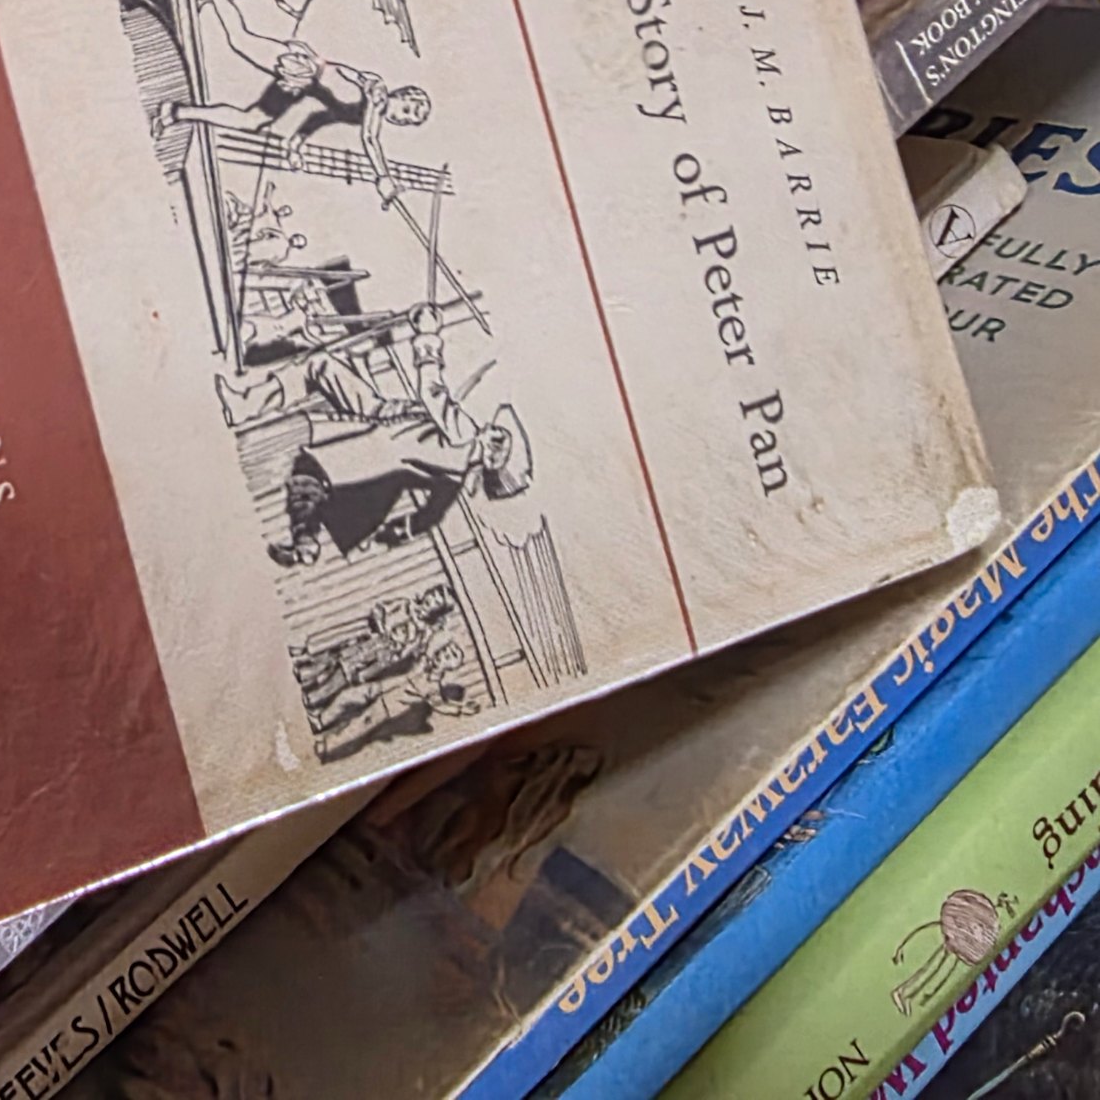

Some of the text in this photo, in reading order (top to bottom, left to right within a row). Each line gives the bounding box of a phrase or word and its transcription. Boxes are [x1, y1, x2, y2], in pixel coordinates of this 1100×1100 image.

[672, 152, 729, 207] of
[738, 5, 841, 287] J. M. BARRIE
[692, 224, 756, 367] Peter
[738, 388, 789, 499] Pan
